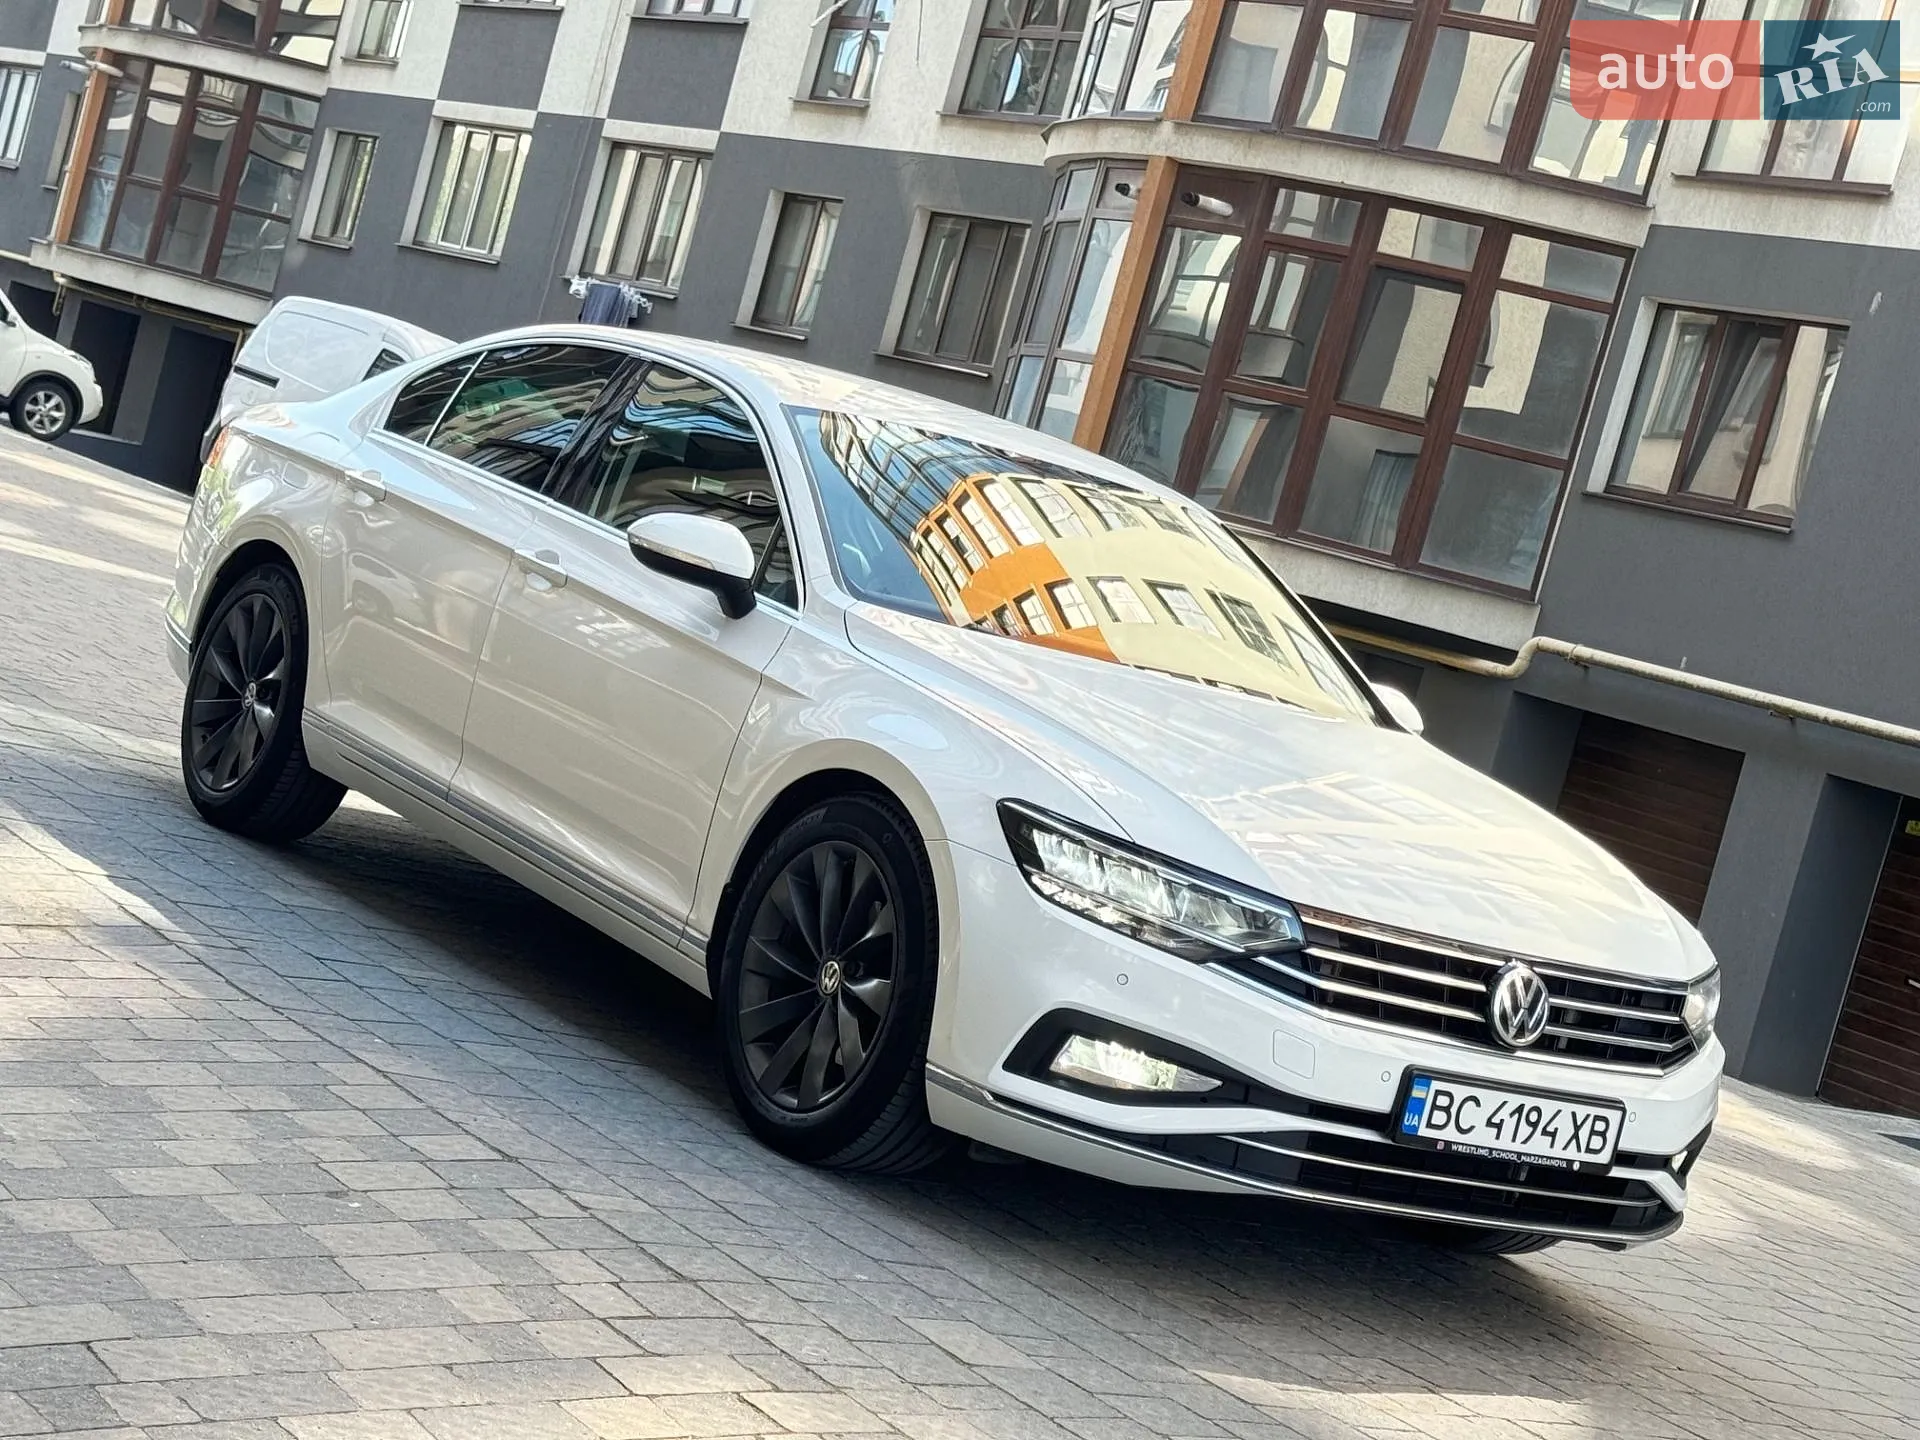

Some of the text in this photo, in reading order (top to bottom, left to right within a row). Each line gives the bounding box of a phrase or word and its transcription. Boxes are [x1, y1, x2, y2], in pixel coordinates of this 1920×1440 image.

[1404, 1112, 1419, 1127] UA
[1425, 1089, 1611, 1155] BC 4194 XB
